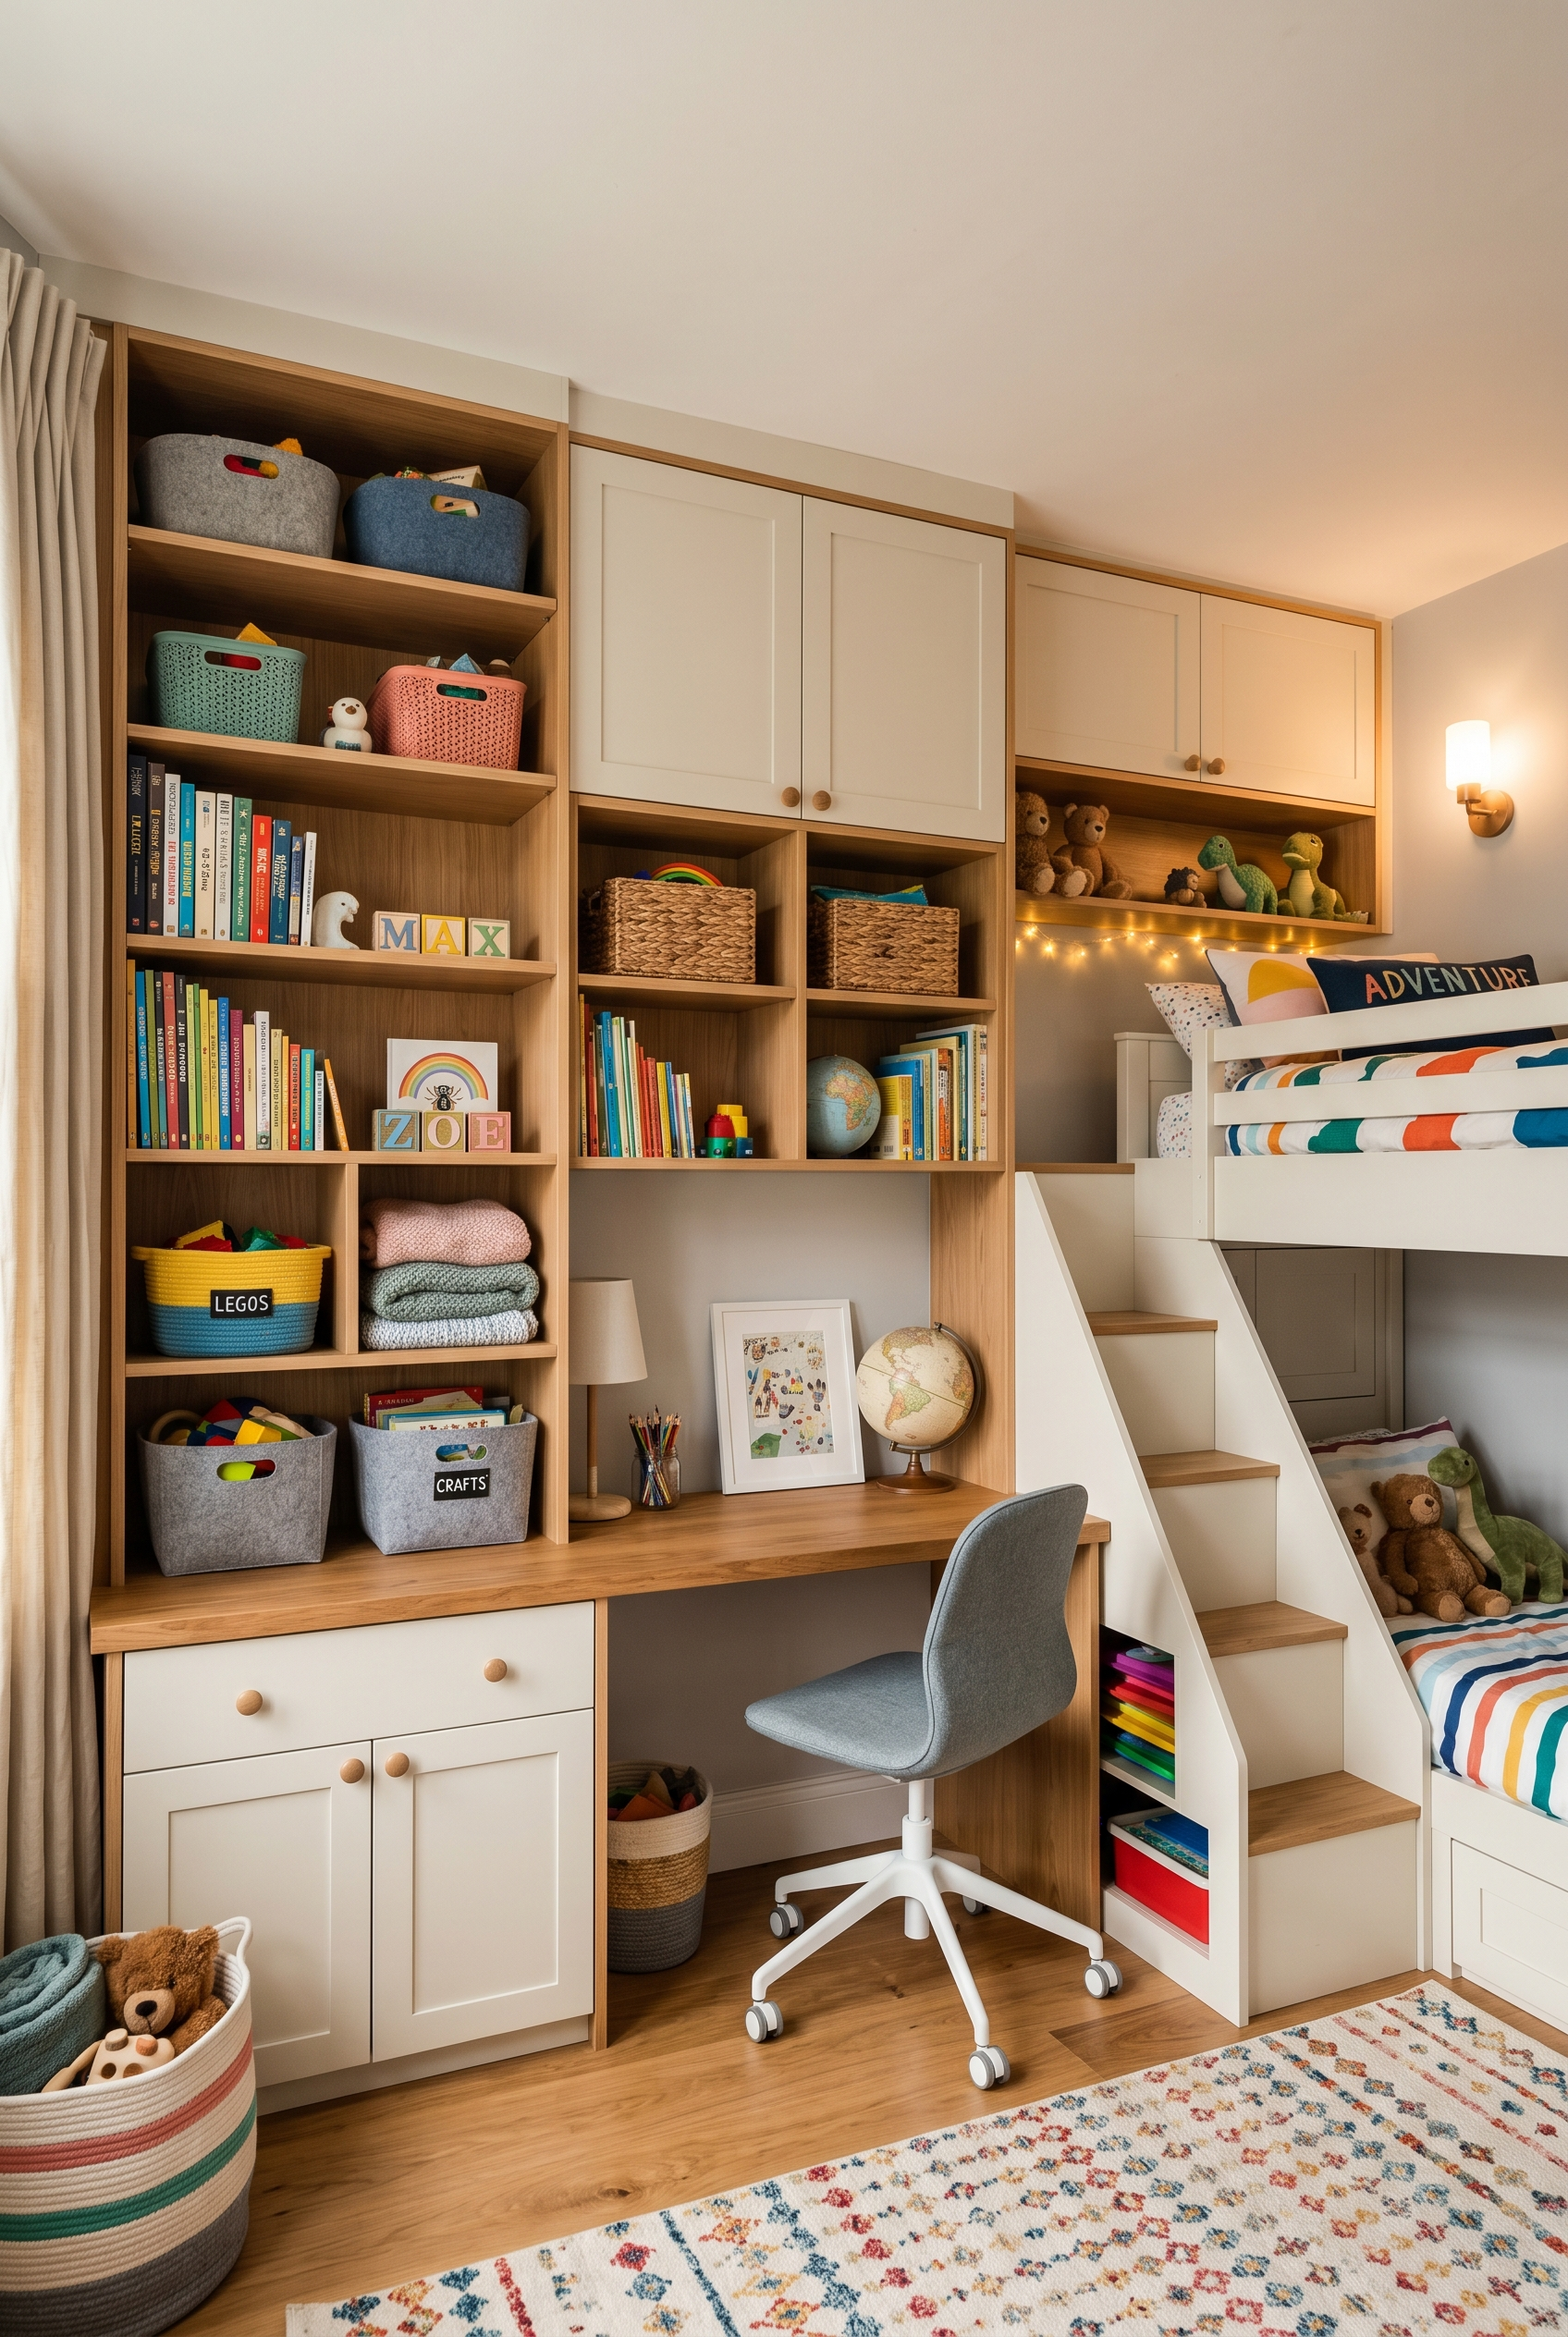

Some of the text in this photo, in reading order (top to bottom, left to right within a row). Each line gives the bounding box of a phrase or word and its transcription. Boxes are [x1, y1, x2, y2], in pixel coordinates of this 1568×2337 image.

[380, 918, 506, 958] MAX
[1366, 967, 1530, 1004] ADVENTURE
[383, 1114, 504, 1149] ZOE
[215, 1294, 269, 1313] LEGOS
[436, 1476, 486, 1493] CRAFTS
